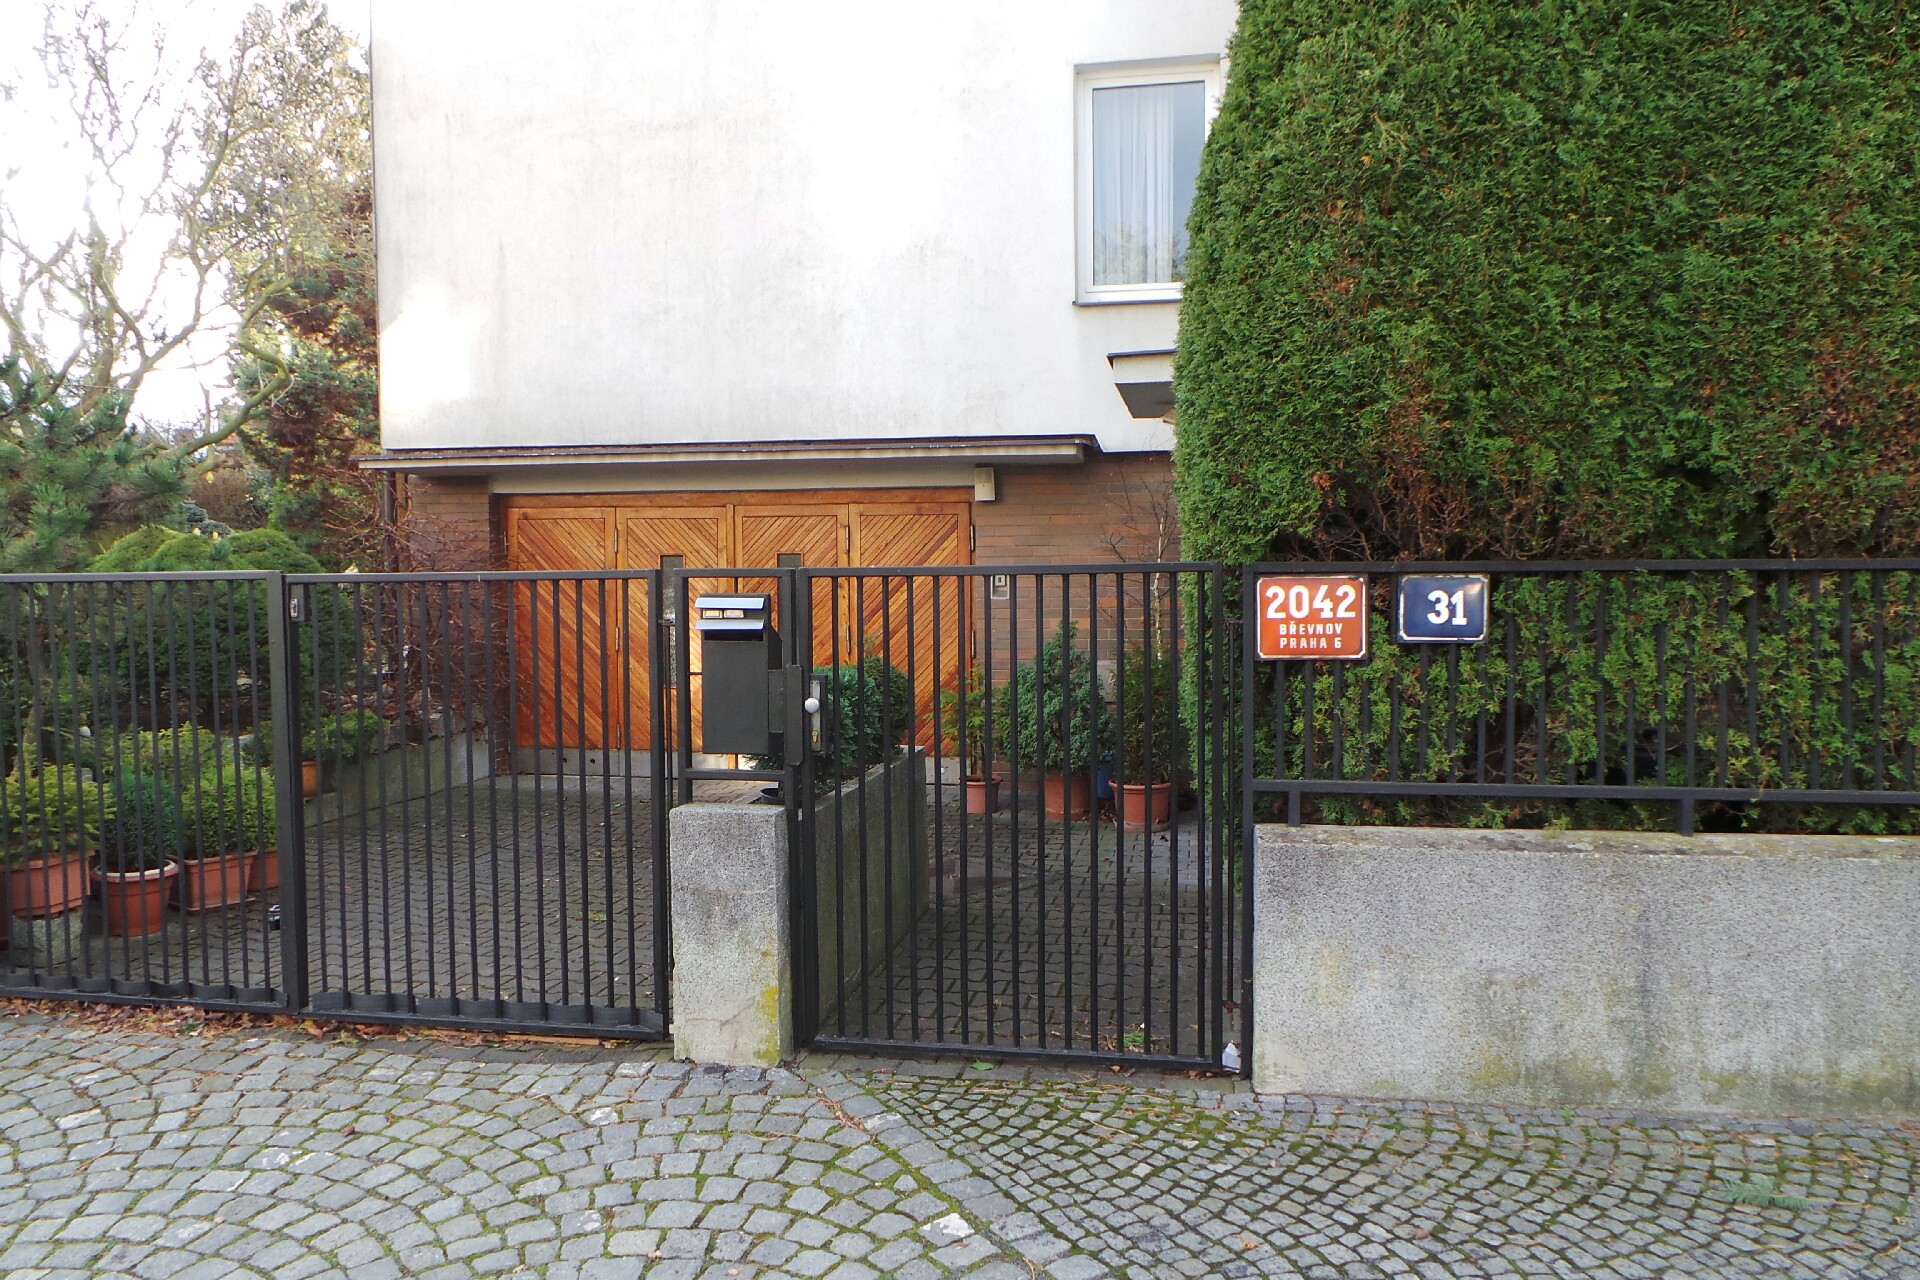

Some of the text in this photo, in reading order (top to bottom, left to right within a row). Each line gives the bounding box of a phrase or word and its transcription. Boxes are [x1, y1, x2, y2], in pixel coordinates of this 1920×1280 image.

[1265, 585, 1356, 619] 2042
[1427, 590, 1467, 626] 31
[1279, 621, 1343, 635] BŘEVNOV
[1280, 638, 1342, 649] PRAHA 6
